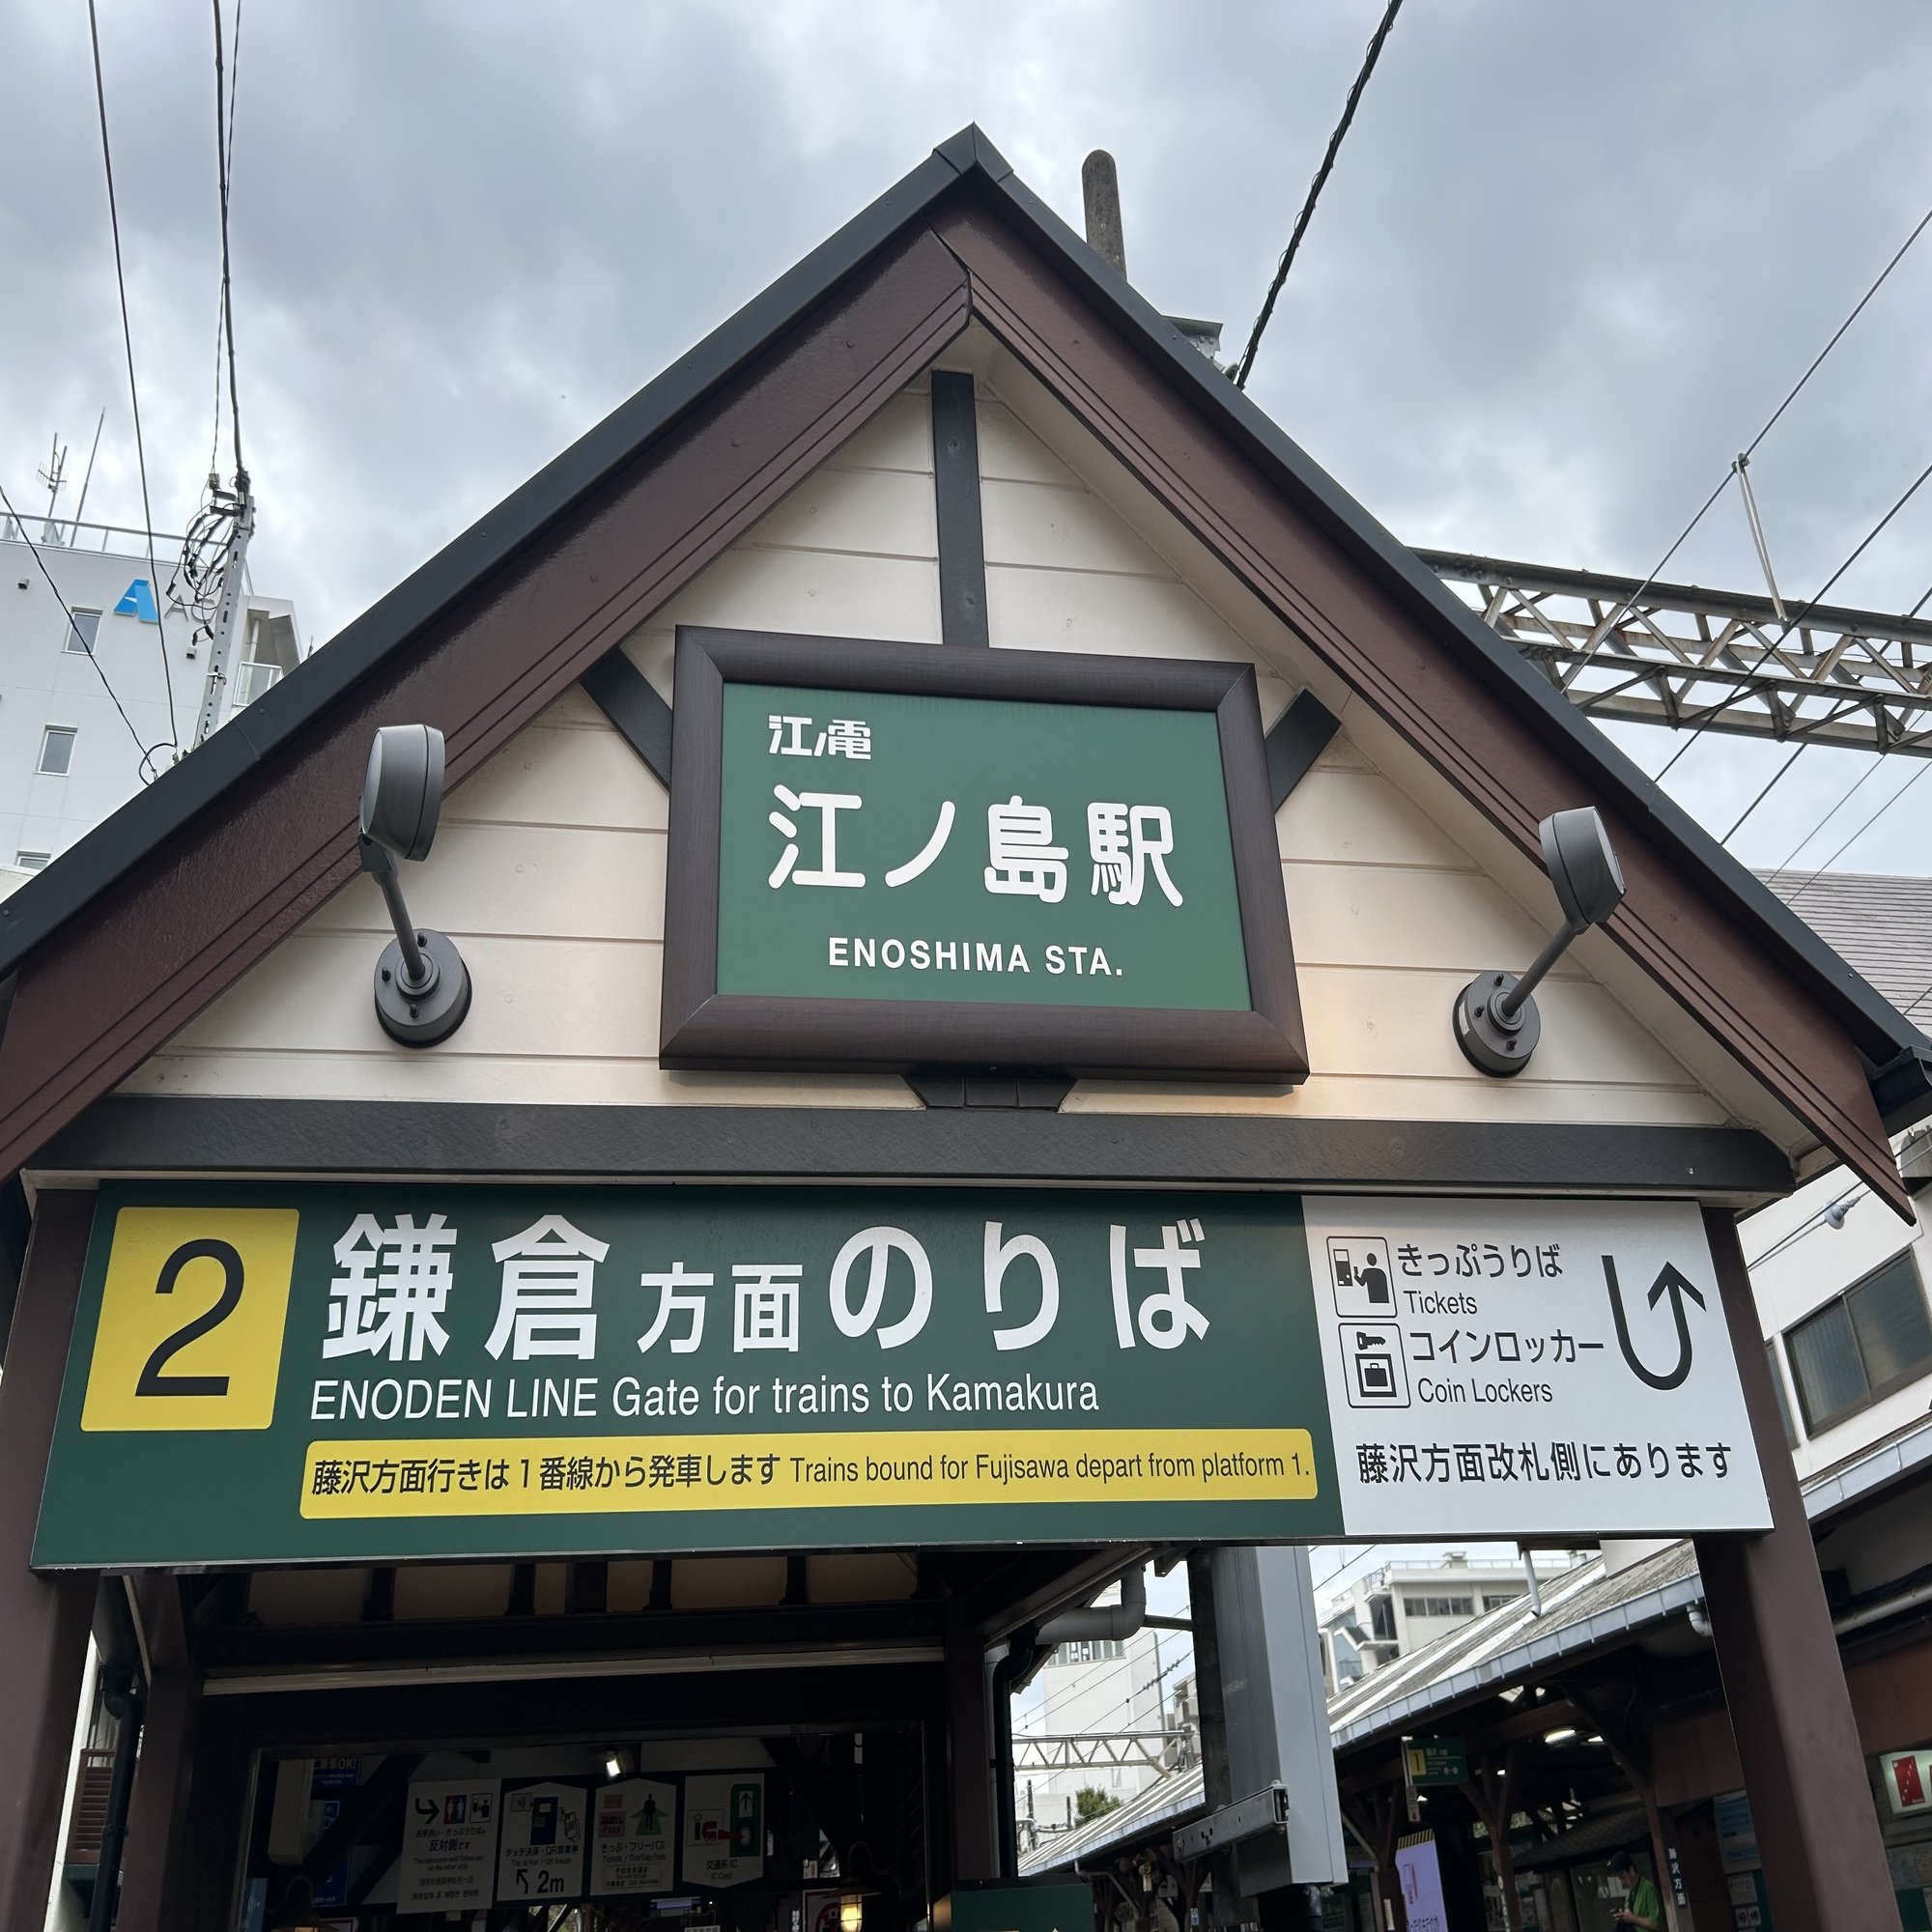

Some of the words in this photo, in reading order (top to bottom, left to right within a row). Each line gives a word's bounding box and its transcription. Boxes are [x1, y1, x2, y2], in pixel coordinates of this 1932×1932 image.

[769, 783, 1183, 907] 江ノ島駅
[828, 937, 1031, 974] ENOSHIMA
[1044, 946, 1124, 977] STA.
[1397, 1242, 1563, 1279] きっぷうりば
[322, 1213, 1210, 1361] 鎌倉方面のりば
[1403, 1291, 1478, 1316] Tickets
[135, 1238, 245, 1397] 2
[1409, 1328, 1605, 1365] コインロッカー
[311, 1378, 491, 1422] ENODEN
[507, 1378, 598, 1419] LINE
[612, 1376, 699, 1418] Gate
[713, 1376, 761, 1415] for
[772, 1376, 870, 1413] trains
[881, 1376, 914, 1412] to
[926, 1373, 1099, 1411] Kamakura
[1417, 1378, 1465, 1404] Coin
[1472, 1378, 1553, 1404] Lockers
[790, 1457, 860, 1484] Trains
[865, 1454, 934, 1482] bound
[939, 1453, 969, 1480] for
[975, 1452, 1070, 1487] Fujisawa
[1074, 1451, 1143, 1485] depart
[1147, 1451, 1196, 1479] from
[1201, 1450, 1286, 1484] platform
[1292, 1452, 1310, 1478] 1.
[1355, 1440, 1733, 1485] 藤沢方面改札側にあります
[537, 1869, 564, 1893] 2m
